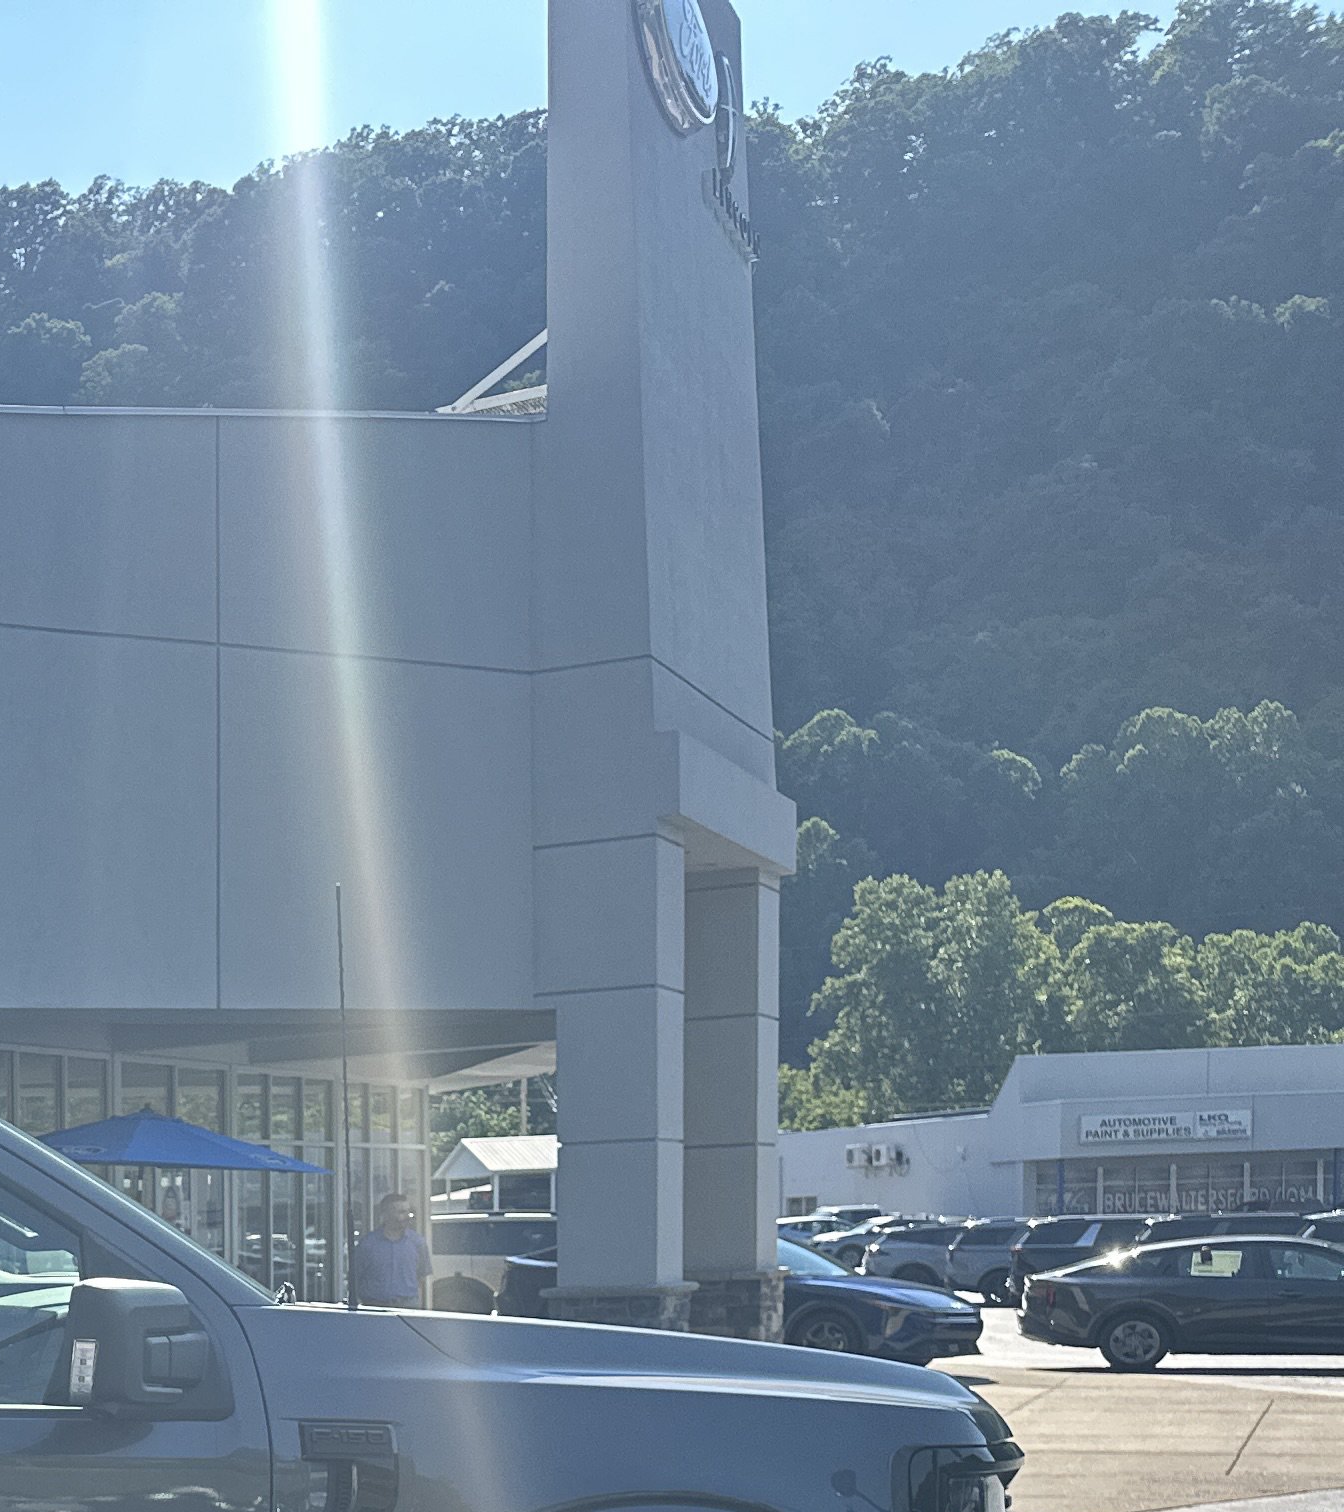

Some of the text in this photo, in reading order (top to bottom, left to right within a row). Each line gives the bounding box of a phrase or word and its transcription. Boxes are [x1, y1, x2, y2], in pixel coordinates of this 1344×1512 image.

[1099, 1115, 1177, 1128] AUTOMOTIVE
[1085, 1126, 1192, 1140] PAINT & SUPPLIES
[1104, 1185, 1314, 1213] BRUCEWALTERSFORDCOM
[311, 1428, 386, 1444] F-150
